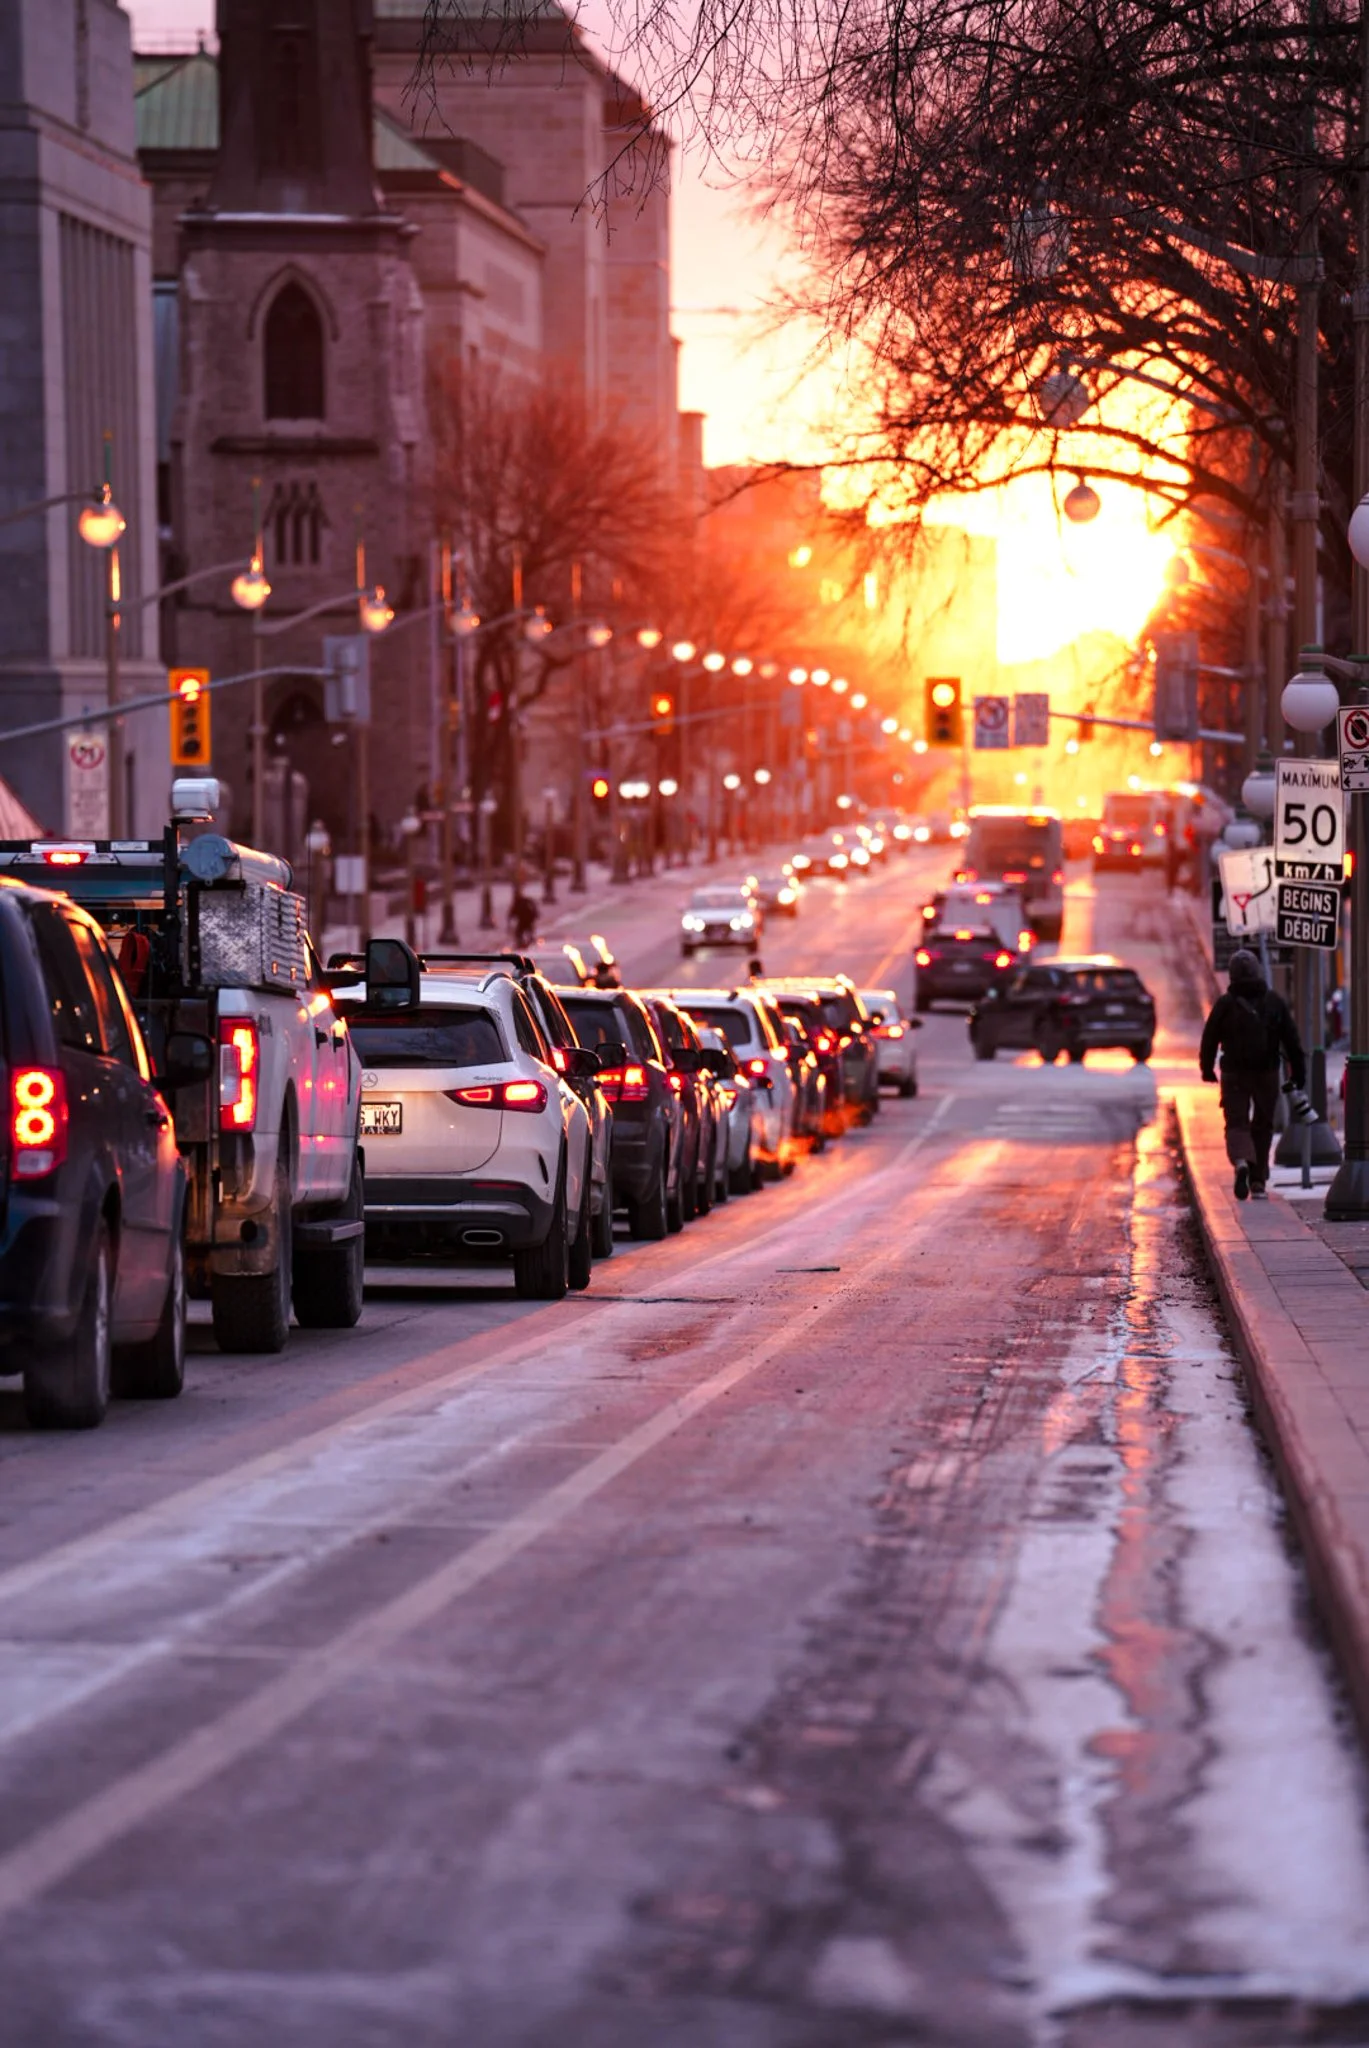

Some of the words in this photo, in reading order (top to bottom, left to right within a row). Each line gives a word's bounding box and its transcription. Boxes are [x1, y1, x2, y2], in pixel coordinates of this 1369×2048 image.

[1282, 773, 1340, 790] MAXIMUM
[1283, 803, 1337, 846] 50
[1283, 863, 1335, 880] km/h
[1283, 888, 1332, 914] BEGINS
[1284, 917, 1328, 943] DÉBUT
[374, 1110, 398, 1126] WKY
